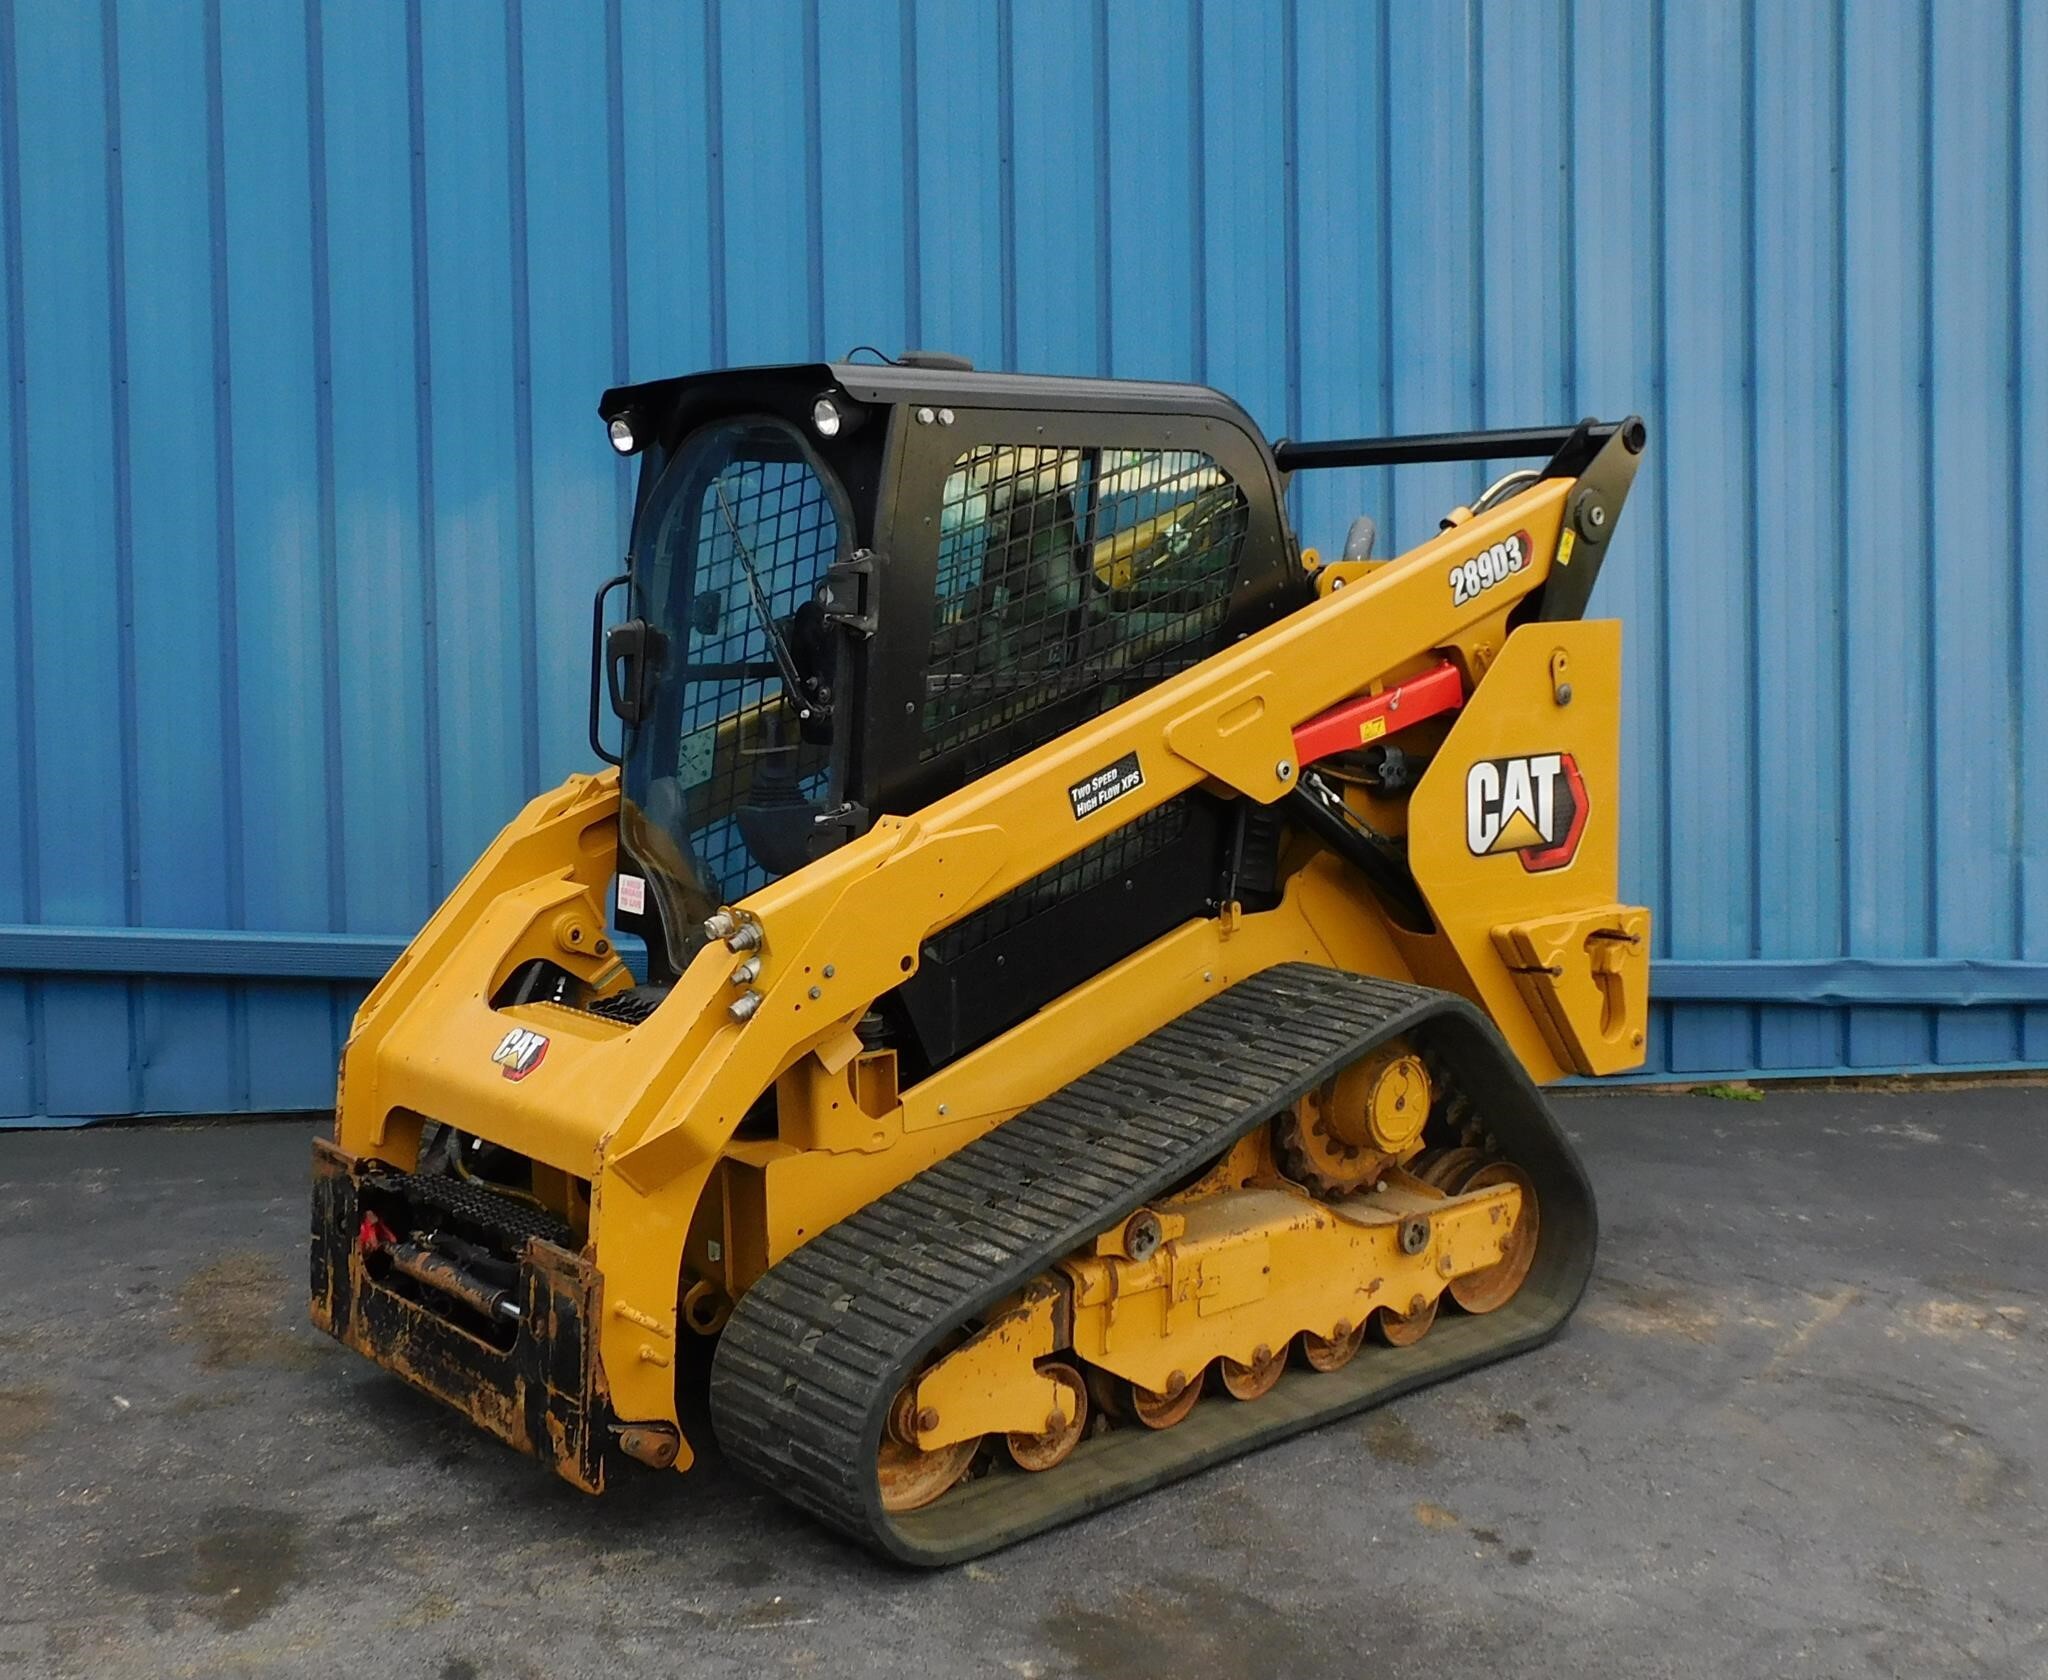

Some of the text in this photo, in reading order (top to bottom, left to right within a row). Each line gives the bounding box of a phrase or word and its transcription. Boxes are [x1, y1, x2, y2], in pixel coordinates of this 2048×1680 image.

[1449, 535, 1522, 606] 289D3
[1121, 770, 1139, 791] XPS
[1467, 755, 1561, 854] CAT
[493, 1028, 546, 1069] CAT
